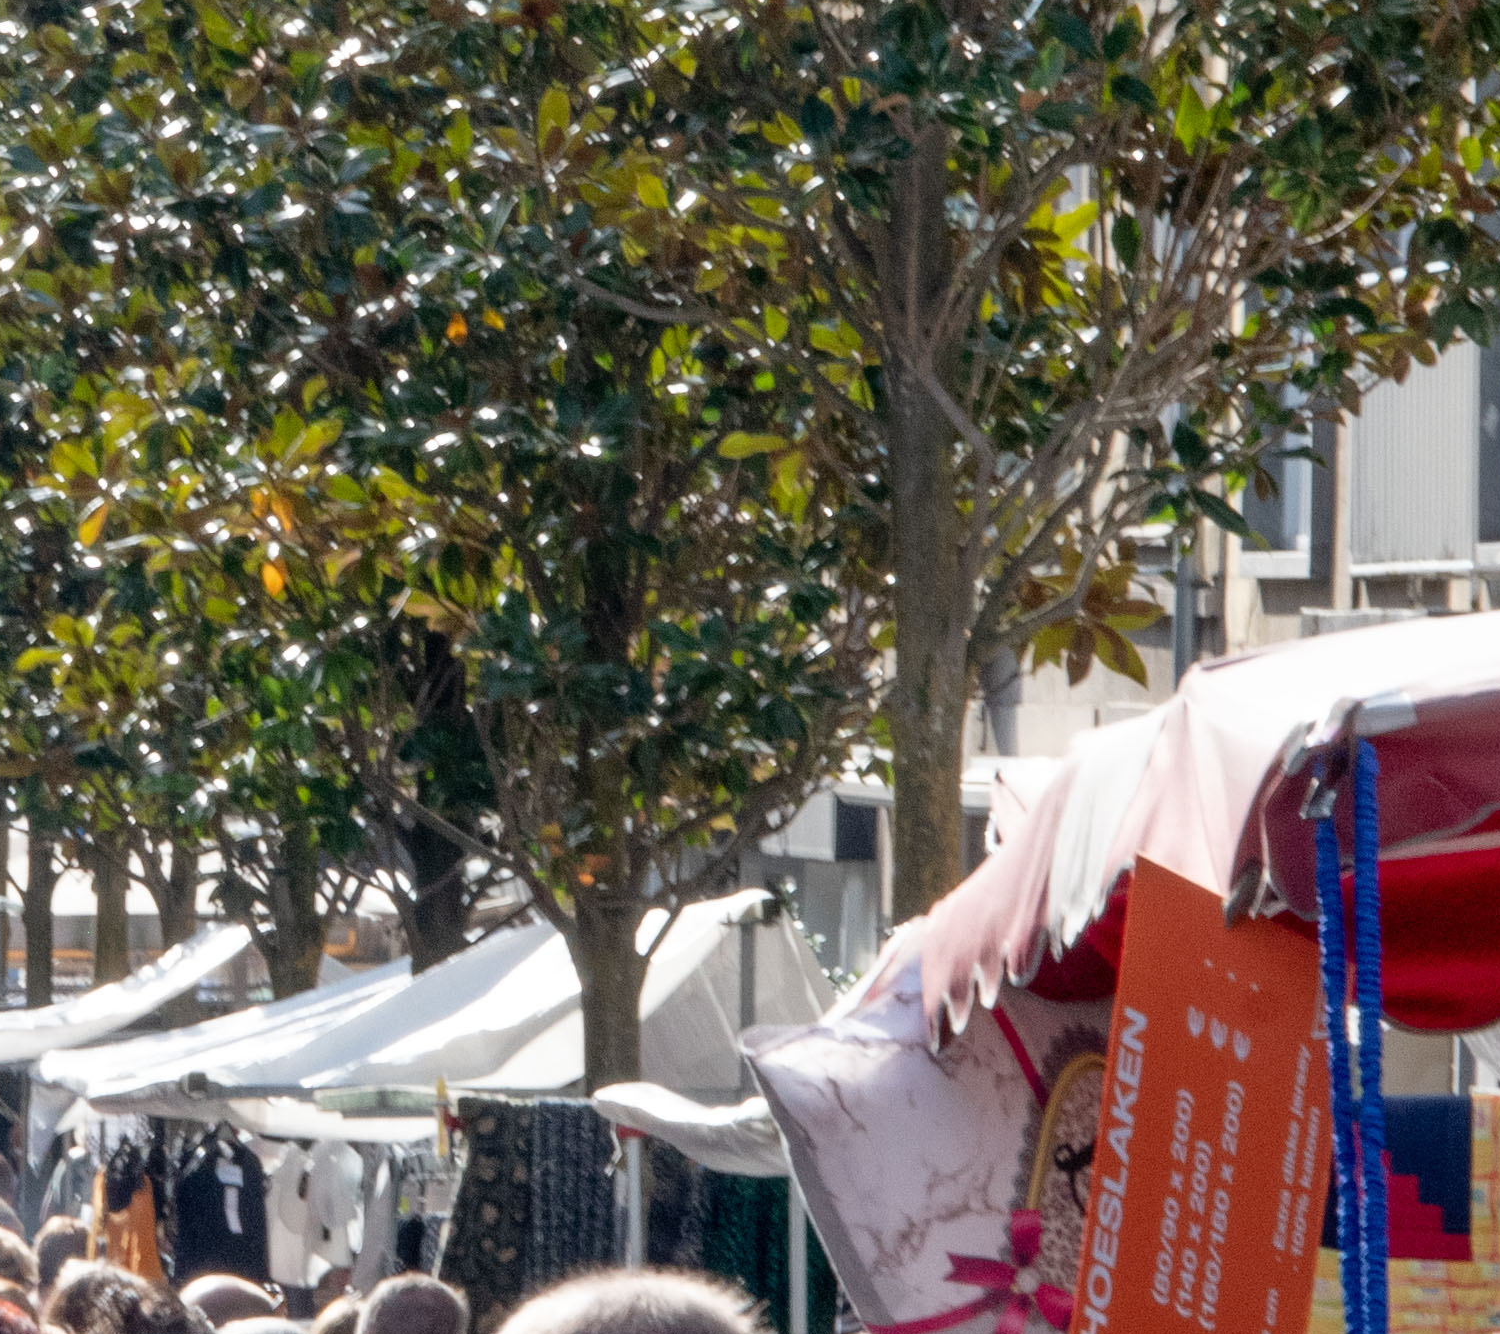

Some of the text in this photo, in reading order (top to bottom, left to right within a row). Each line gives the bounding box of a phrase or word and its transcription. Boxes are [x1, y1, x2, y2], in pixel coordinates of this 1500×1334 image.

[1186, 1005, 1206, 1039] €
[1209, 1017, 1229, 1050] €
[1232, 1029, 1252, 1063] €
[1170, 1088, 1195, 1164] 200)
[1220, 1080, 1245, 1156] 200)
[1169, 1171, 1185, 1192] x
[1188, 1140, 1213, 1216] 200)
[1220, 1163, 1234, 1185] x
[1272, 1189, 1292, 1251] Extra
[1282, 1120, 1300, 1185] dikke
[1188, 1222, 1203, 1244] x
[1174, 1247, 1199, 1319] (140
